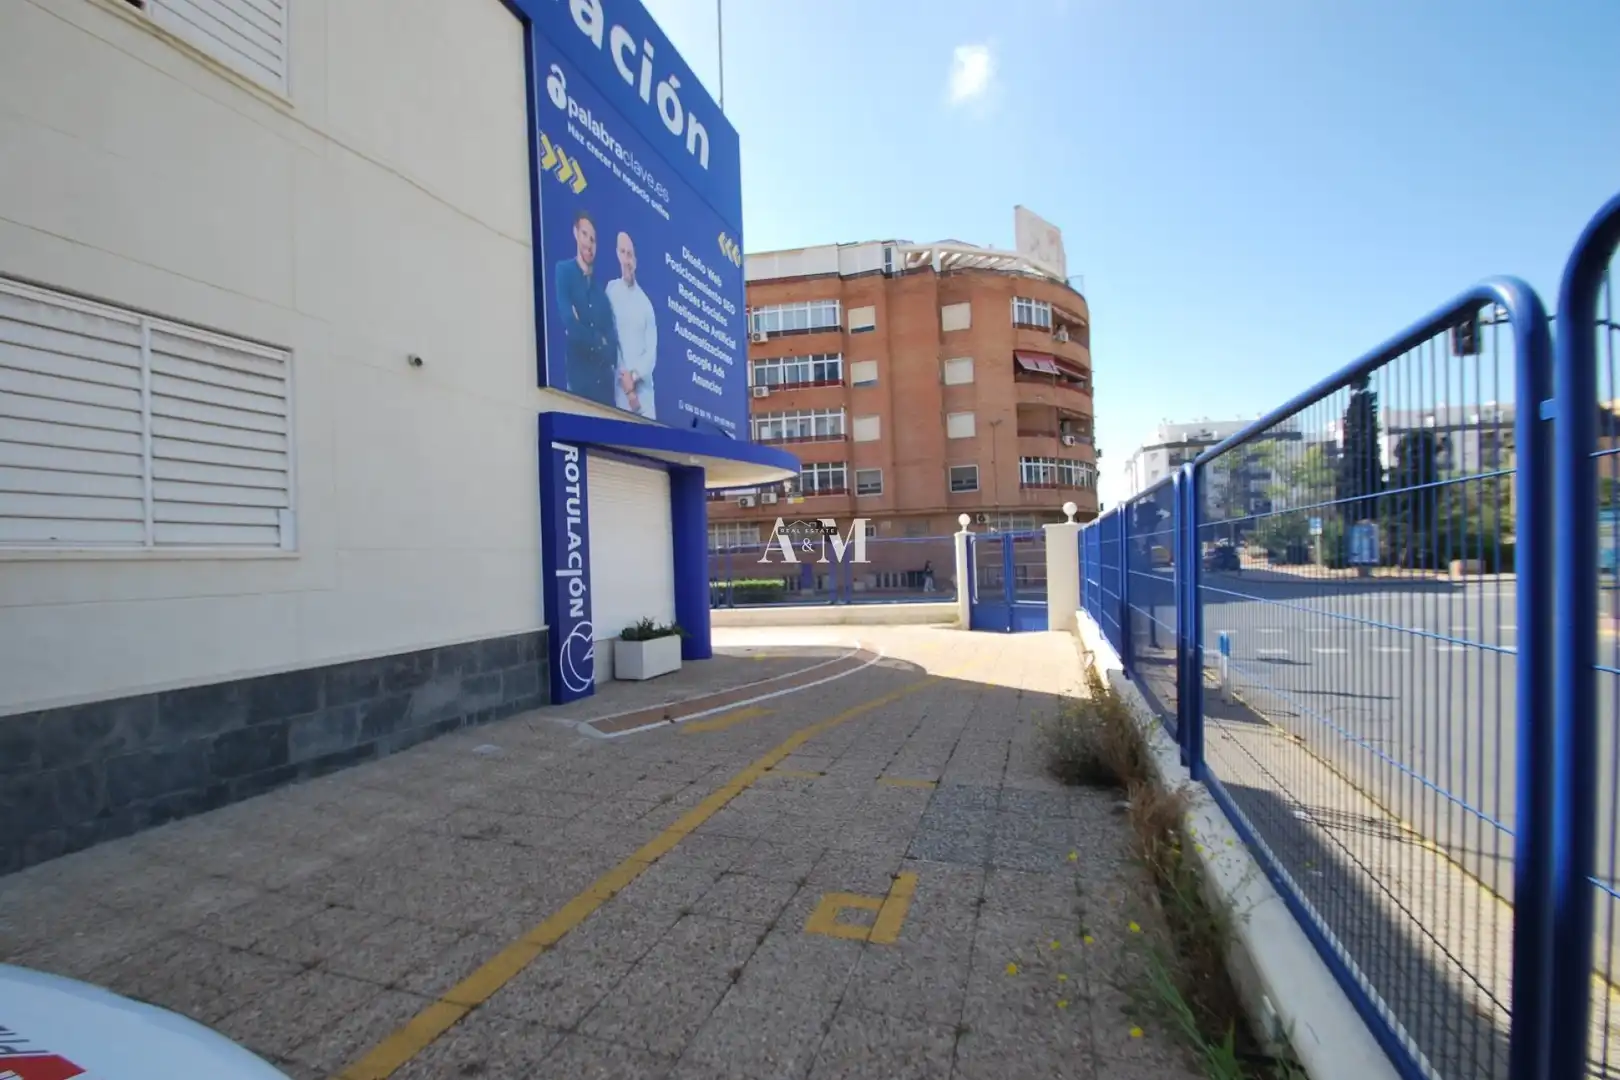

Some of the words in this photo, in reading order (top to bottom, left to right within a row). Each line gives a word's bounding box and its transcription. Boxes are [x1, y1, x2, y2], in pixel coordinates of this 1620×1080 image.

[556, 0, 710, 171] ación
[567, 95, 670, 203] palabraclave.es
[567, 121, 585, 146] Haz
[586, 141, 612, 169] crecer
[612, 162, 622, 179] tu
[622, 172, 650, 204] negocio
[665, 251, 722, 306] Posicionamiento
[722, 298, 736, 316] SEO
[682, 245, 706, 275] Diseño
[706, 266, 722, 289] Web
[667, 295, 710, 334] Inteligencia
[710, 325, 737, 350] Artificial
[678, 283, 701, 309] Redes
[701, 300, 728, 327] Sociales
[674, 321, 733, 366] Automatizaciones
[686, 348, 712, 372] Google
[712, 363, 725, 379] Ads
[692, 371, 723, 397] Anuncios
[551, 441, 587, 618] ROTULACIÓN
